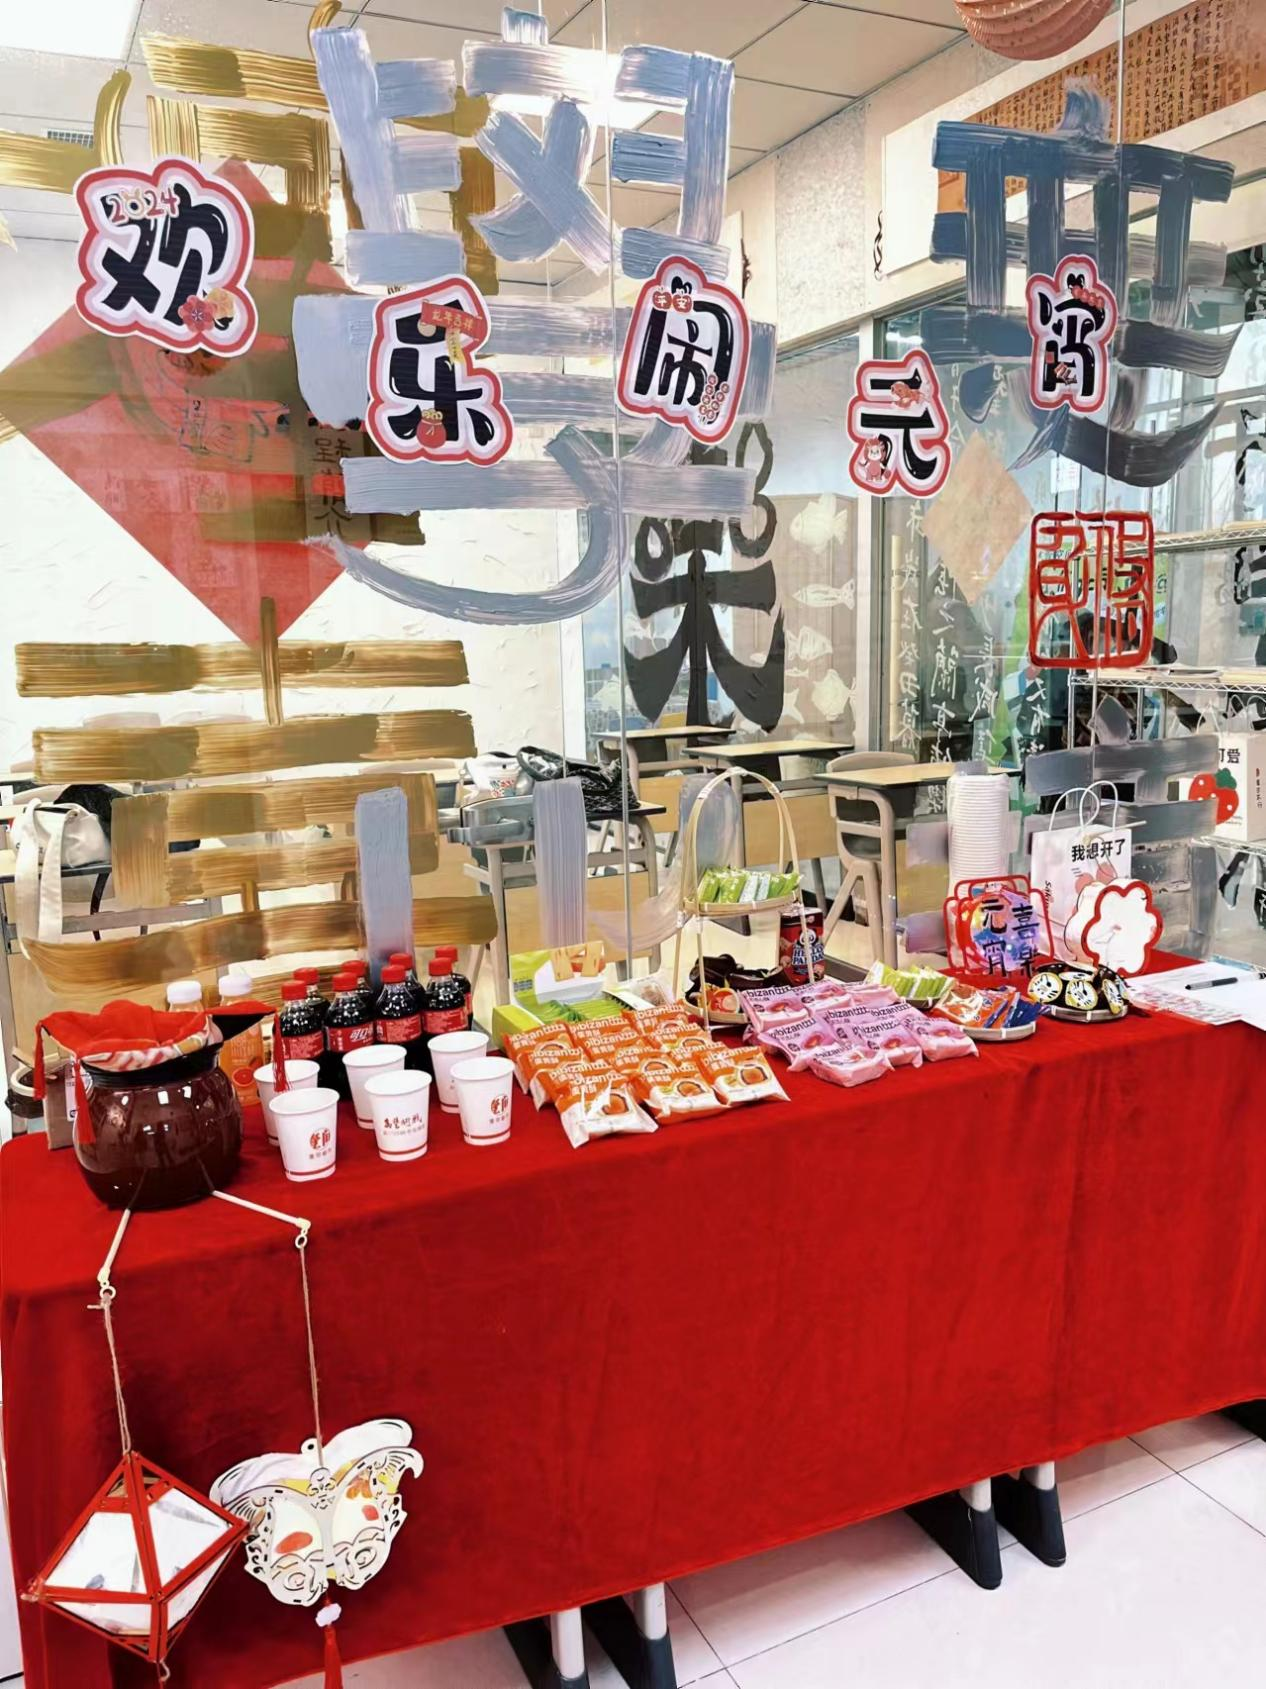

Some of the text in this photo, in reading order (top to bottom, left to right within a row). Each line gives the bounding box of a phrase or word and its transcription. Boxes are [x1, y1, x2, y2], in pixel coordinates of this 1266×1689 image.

[107, 187, 178, 223] 2024
[656, 294, 689, 311] 平安
[101, 183, 235, 330] 欢
[388, 299, 494, 446] 乐
[633, 274, 734, 405] 闹
[861, 369, 937, 479] 元
[1039, 273, 1106, 396] 宵
[1071, 838, 1126, 863] 我想开了
[981, 899, 1007, 977] 元宵
